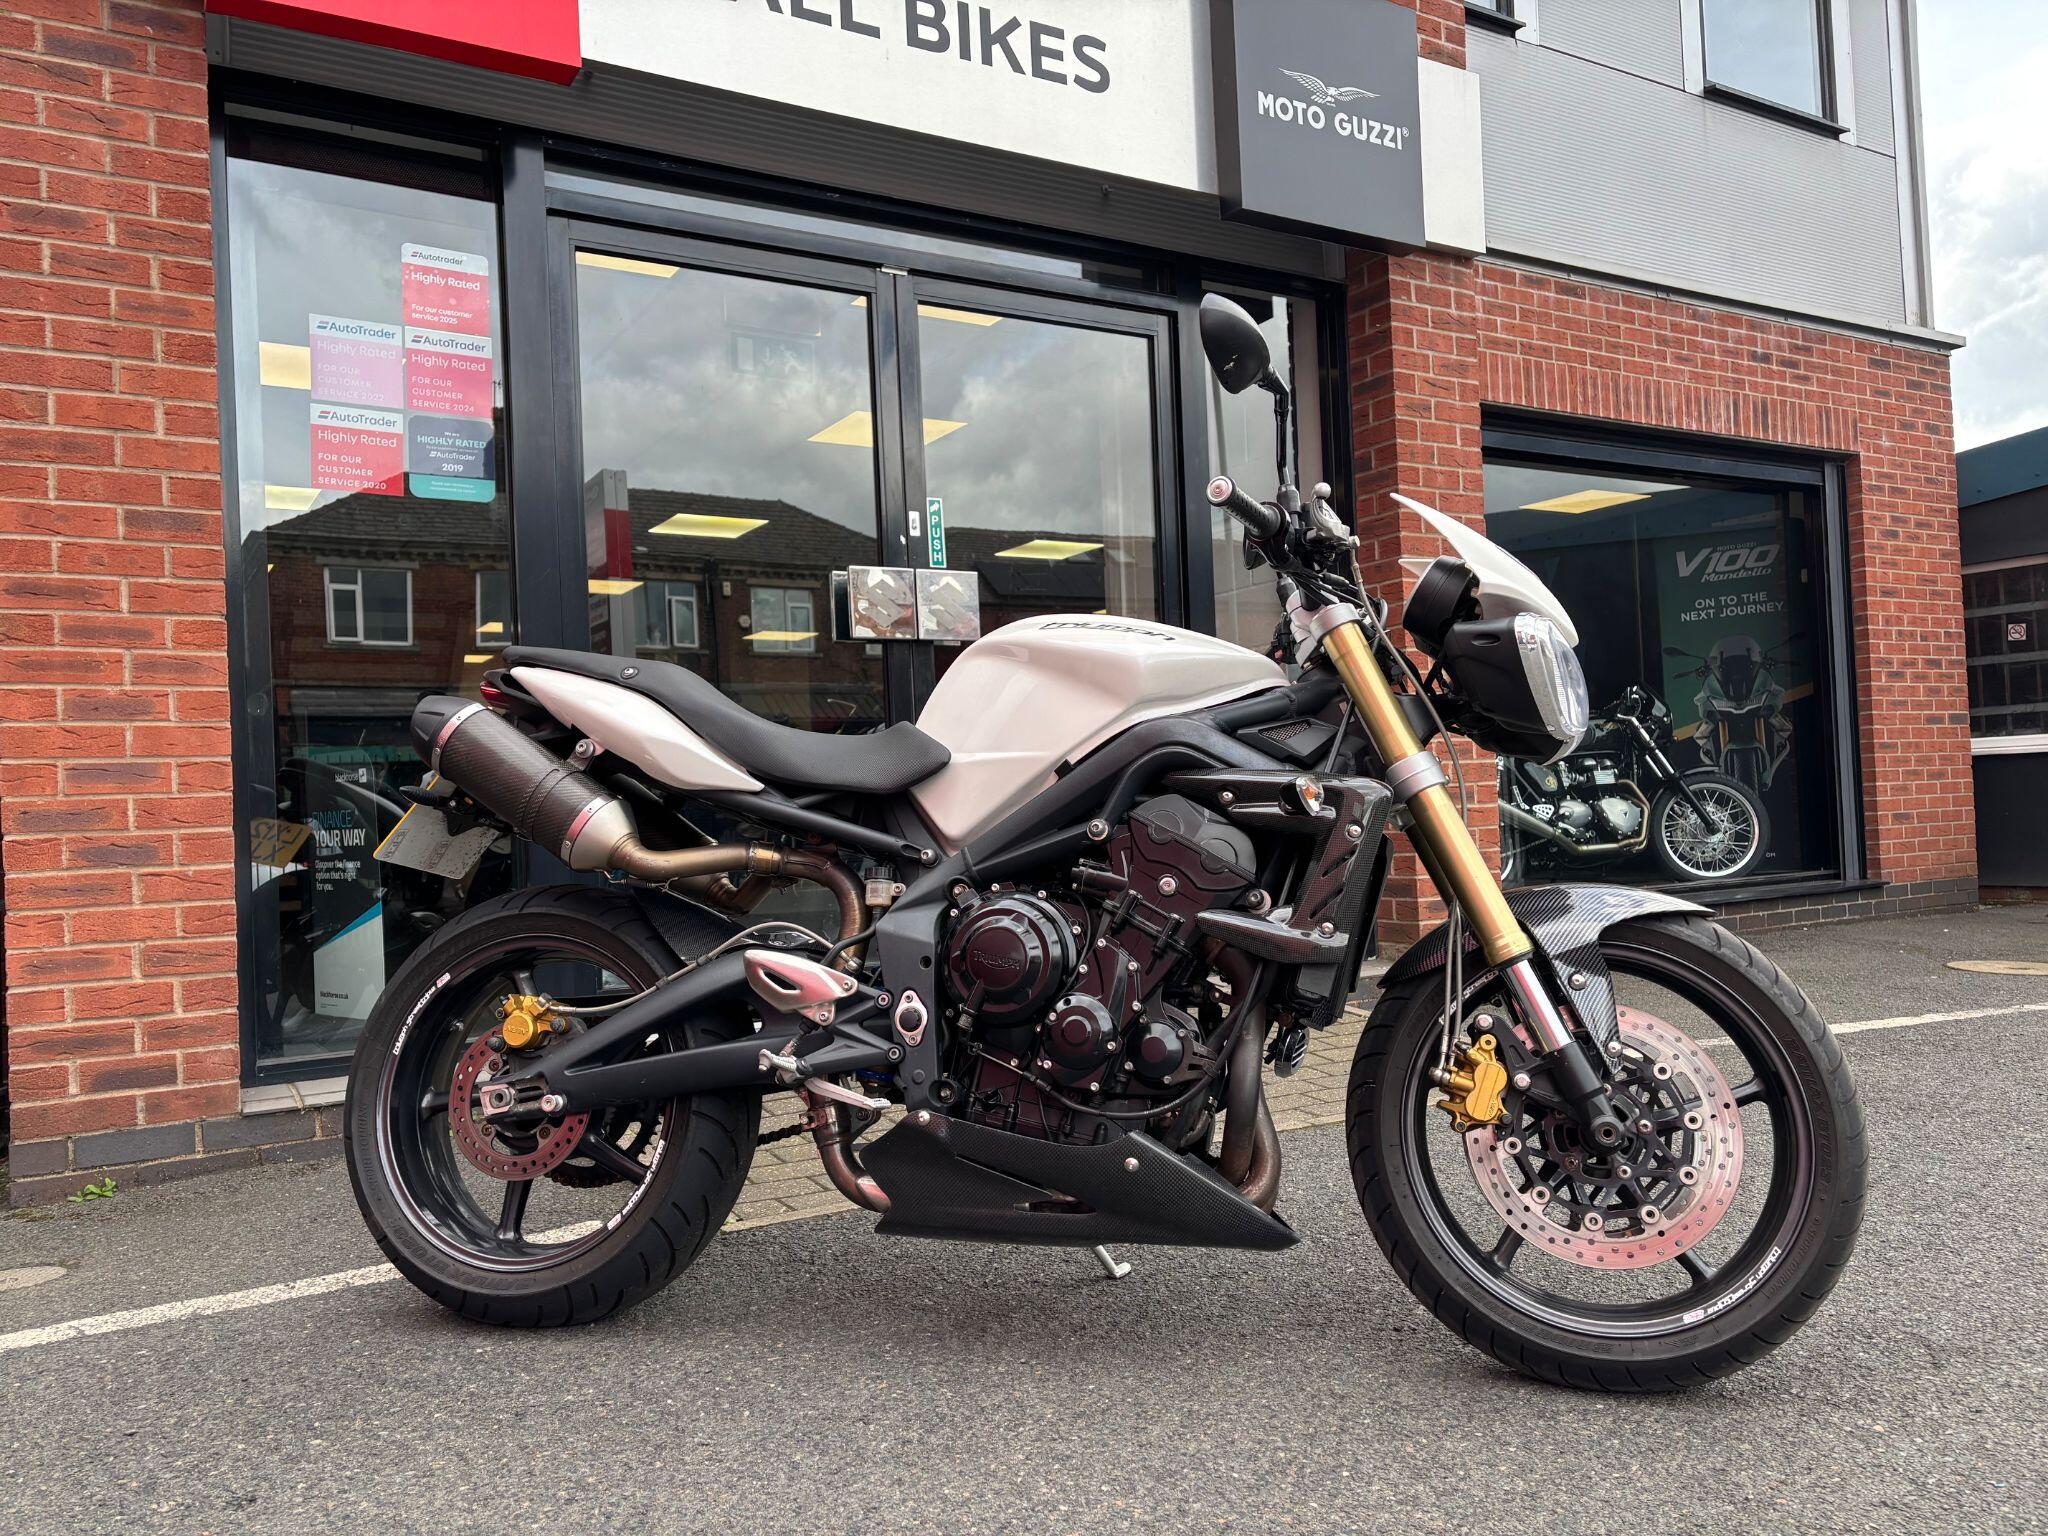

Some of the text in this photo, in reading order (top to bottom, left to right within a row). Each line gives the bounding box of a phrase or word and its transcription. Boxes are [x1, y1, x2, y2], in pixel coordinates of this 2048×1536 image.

[904, 0, 1111, 94] BIKES
[1257, 90, 1326, 130] MOTO
[418, 251, 463, 265] Autotrader
[411, 271, 480, 290] Highly Rated
[411, 303, 424, 311] For
[438, 307, 473, 318] customer
[411, 312, 458, 325] service 2025
[329, 322, 396, 339] AutoTrader
[317, 340, 396, 359] Highly Rated
[423, 336, 486, 352] AutoTrader
[318, 362, 360, 375] FOR OUR
[411, 353, 486, 372] Highly Rated
[411, 376, 452, 387] FOR OUR
[318, 387, 359, 399] SERVICE
[412, 387, 463, 399] CUSTOMER
[412, 399, 474, 412] SERVICE 2024
[330, 411, 397, 427] AutoTrader
[318, 429, 397, 448] Highly Rated
[417, 435, 486, 449] HIGHLY RATED
[318, 452, 362, 464] FOR OUR
[436, 451, 476, 461] AutoTrader
[318, 464, 374, 477] CUSTOMER
[441, 463, 464, 472] 2019
[318, 476, 387, 490] SERVICE 2020
[931, 515, 942, 562] PUSH
[1676, 544, 1781, 578] V100
[1701, 567, 1772, 583] Mandello
[1695, 591, 1768, 609] ON TO THE
[1681, 601, 1784, 622] NEXT JOURNEY
[312, 809, 352, 828] FINANCE
[314, 829, 341, 847] YOUR
[342, 828, 366, 847] WAY
[314, 860, 335, 871] Discover
[315, 872, 330, 881] option
[330, 870, 344, 880] that's
[316, 881, 324, 891] for
